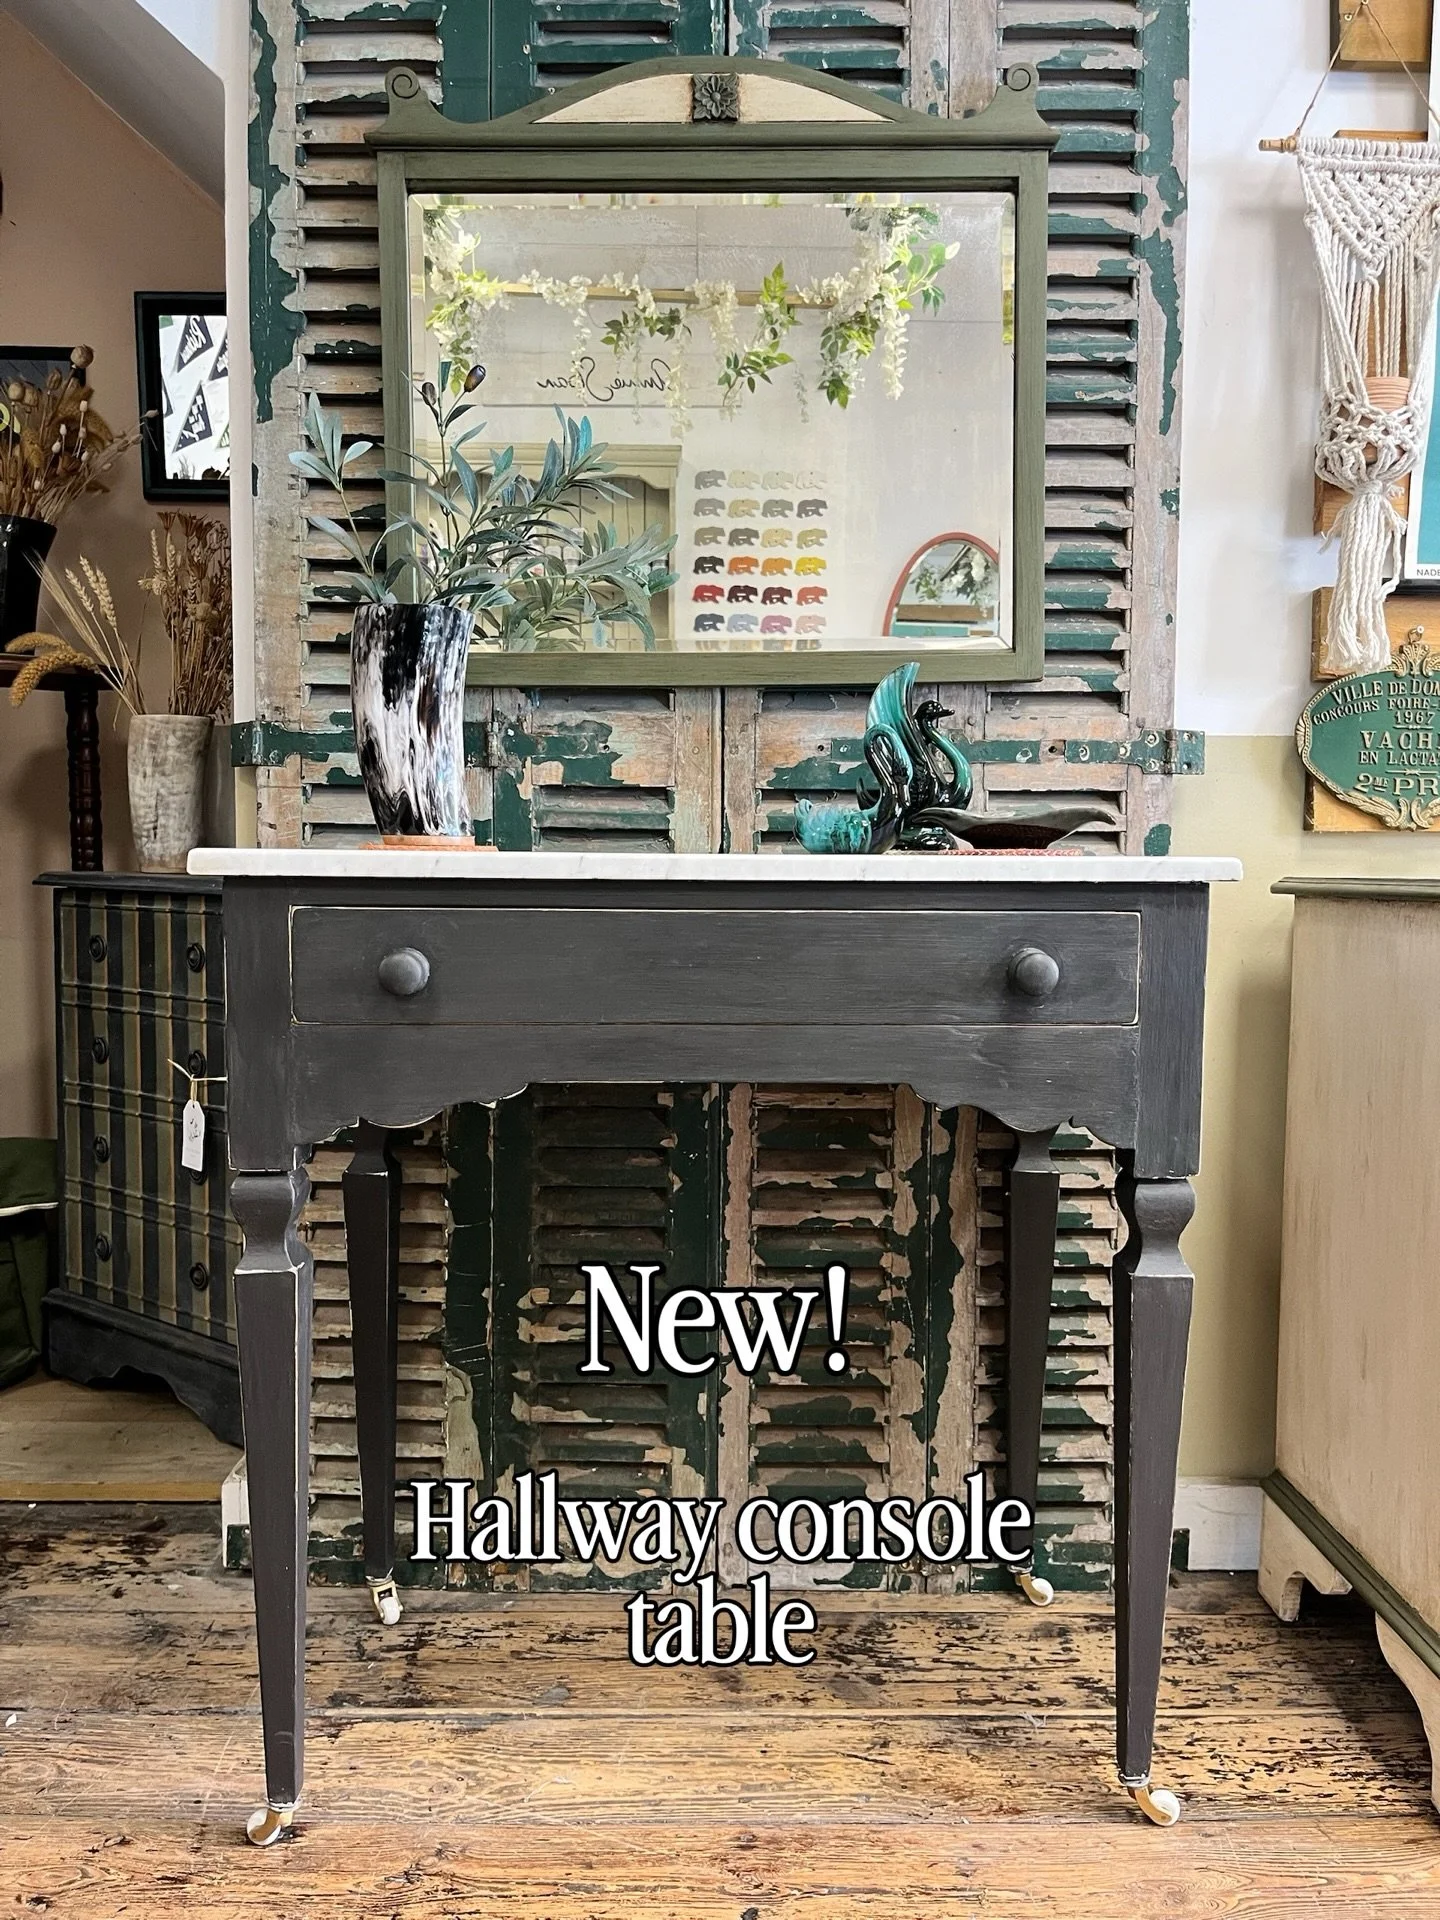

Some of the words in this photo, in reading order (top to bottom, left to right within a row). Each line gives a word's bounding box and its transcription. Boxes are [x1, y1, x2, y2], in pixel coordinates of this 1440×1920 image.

[1331, 680, 1383, 705] VILLE
[1389, 681, 1407, 695] DE
[1313, 700, 1379, 725] CONCOURS
[1388, 697, 1440, 710] FOIRE-
[1395, 710, 1435, 725] 1967
[1360, 730, 1440, 750] VACH
[1359, 750, 1379, 765] EN
[1392, 776, 1440, 796] PR
